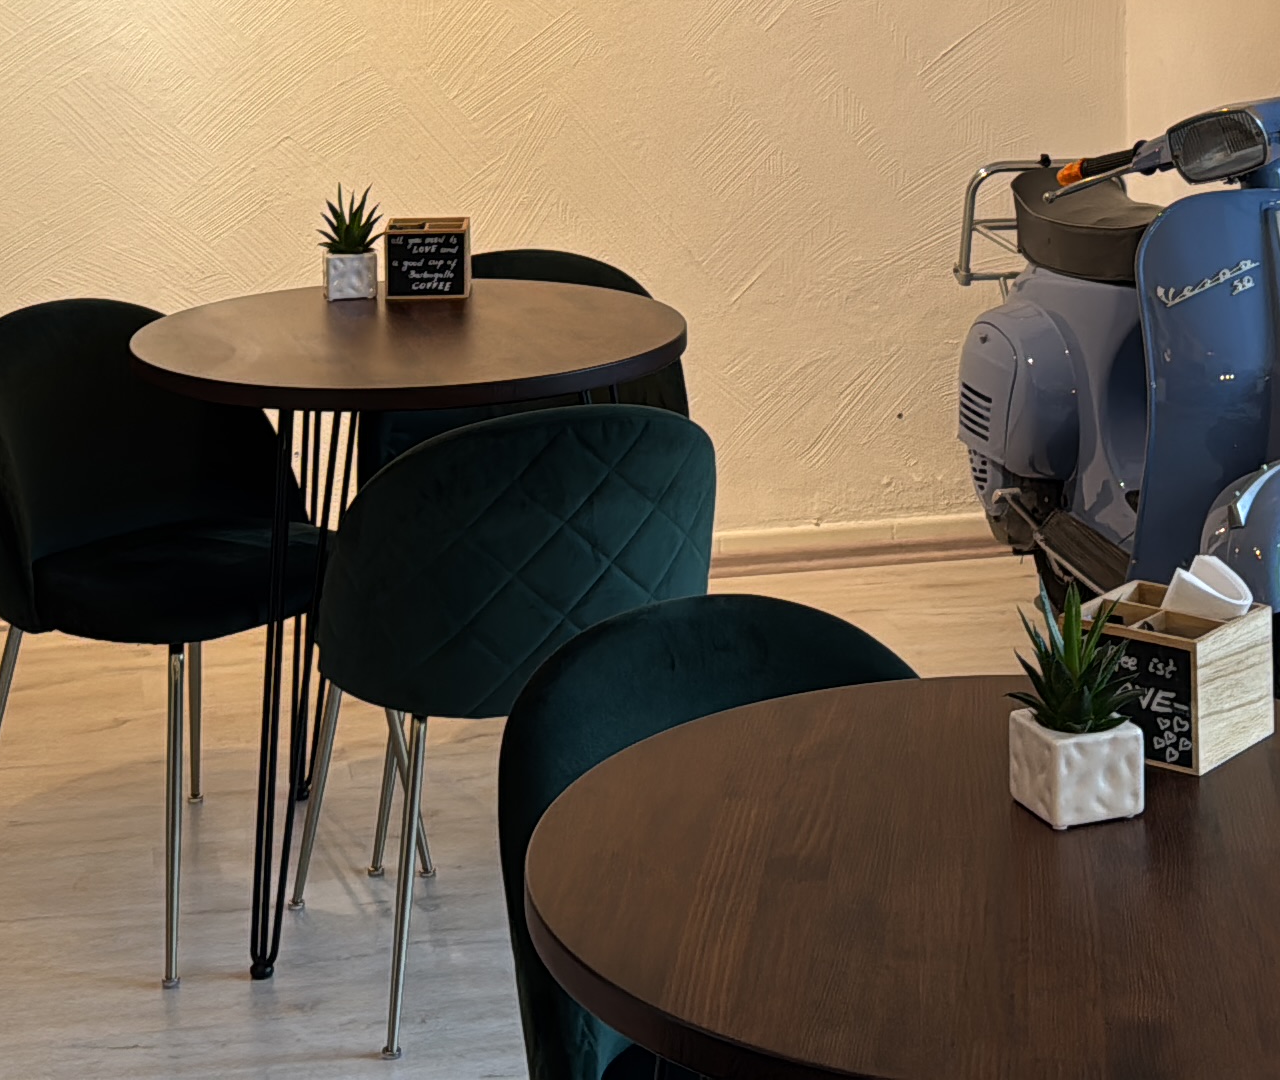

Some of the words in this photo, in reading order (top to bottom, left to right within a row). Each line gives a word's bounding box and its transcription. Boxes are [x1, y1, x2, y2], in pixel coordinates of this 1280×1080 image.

[391, 235, 404, 245] all
[407, 237, 423, 250] you
[449, 235, 458, 245] is
[412, 245, 438, 254] LOVE
[440, 245, 459, 254] and
[401, 257, 425, 272] good
[428, 259, 445, 270] cup
[446, 258, 458, 271] of
[411, 281, 452, 292] COFFEE
[1156, 259, 1260, 308] Vespa
[1231, 275, 1256, 296] 50
[1147, 657, 1178, 679] ist
